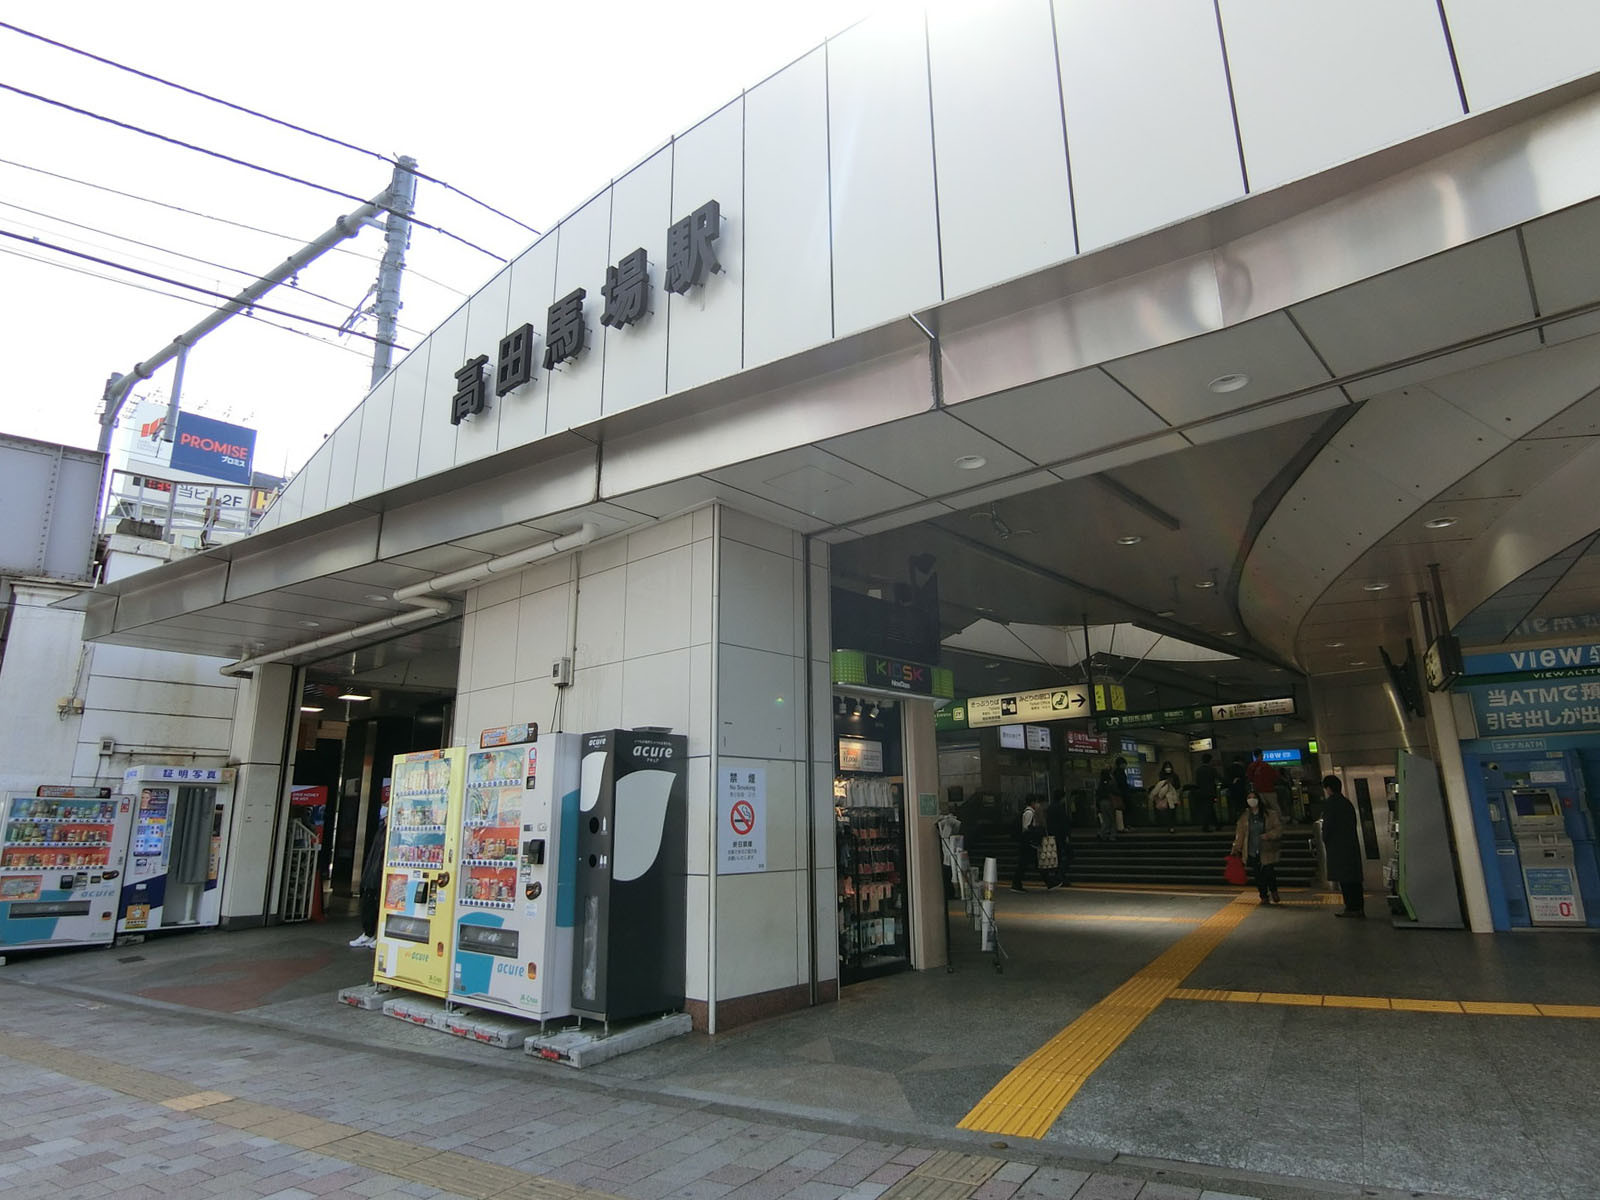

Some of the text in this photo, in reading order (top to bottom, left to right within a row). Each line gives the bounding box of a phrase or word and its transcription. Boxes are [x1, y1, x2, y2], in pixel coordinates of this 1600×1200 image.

[450, 199, 721, 426] 高田馬場駅
[180, 433, 249, 460] PROMISE
[221, 455, 246, 468] プロミス
[1510, 648, 1583, 669] view
[875, 660, 926, 681] KIOSK
[1532, 671, 1566, 679] VIEW
[1106, 717, 1120, 726] JR
[1486, 705, 1600, 730] 引き出しが出
[632, 744, 673, 758] acure
[163, 769, 217, 779] 証明写真
[730, 772, 756, 784] 禁煙
[81, 889, 115, 898] acure
[411, 951, 430, 962] acure
[496, 962, 525, 977] acure
